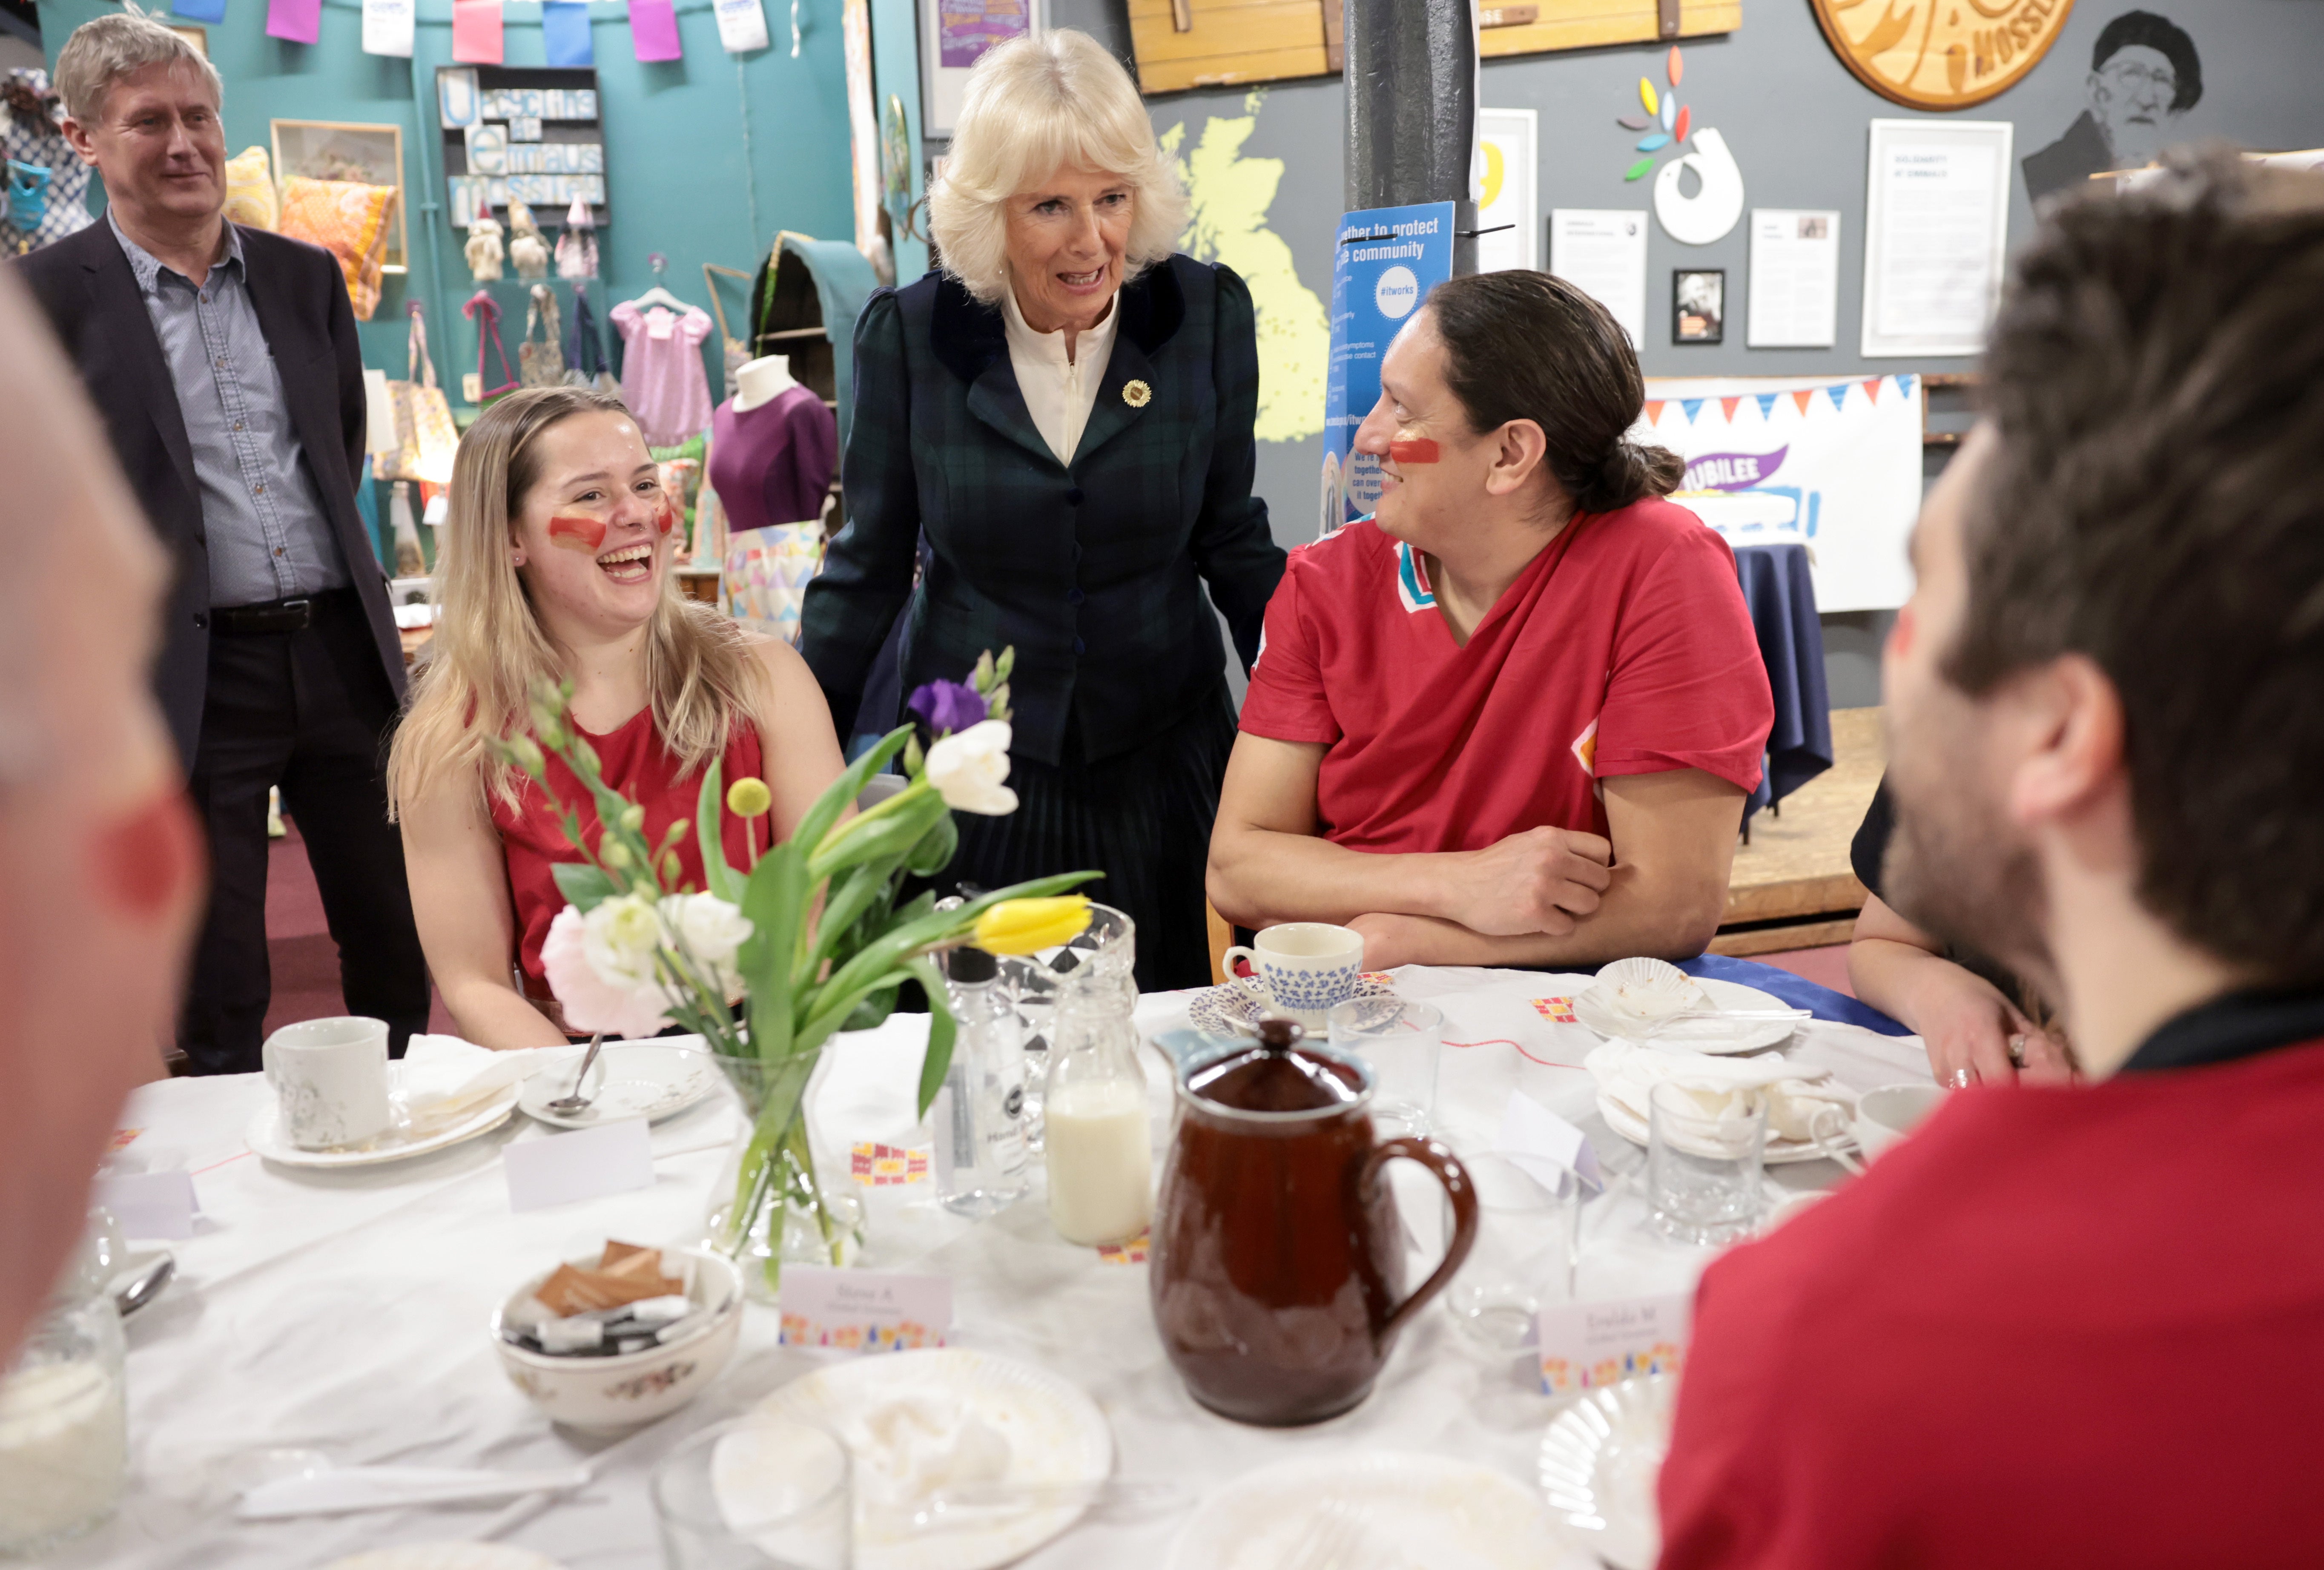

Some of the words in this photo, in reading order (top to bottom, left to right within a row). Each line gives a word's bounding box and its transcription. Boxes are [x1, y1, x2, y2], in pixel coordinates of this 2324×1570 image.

[1374, 224, 1388, 235] to
[1392, 218, 1438, 241] protect
[1353, 241, 1425, 262] community
[1381, 285, 1414, 296] #itworks
[1354, 351, 1376, 359] contact
